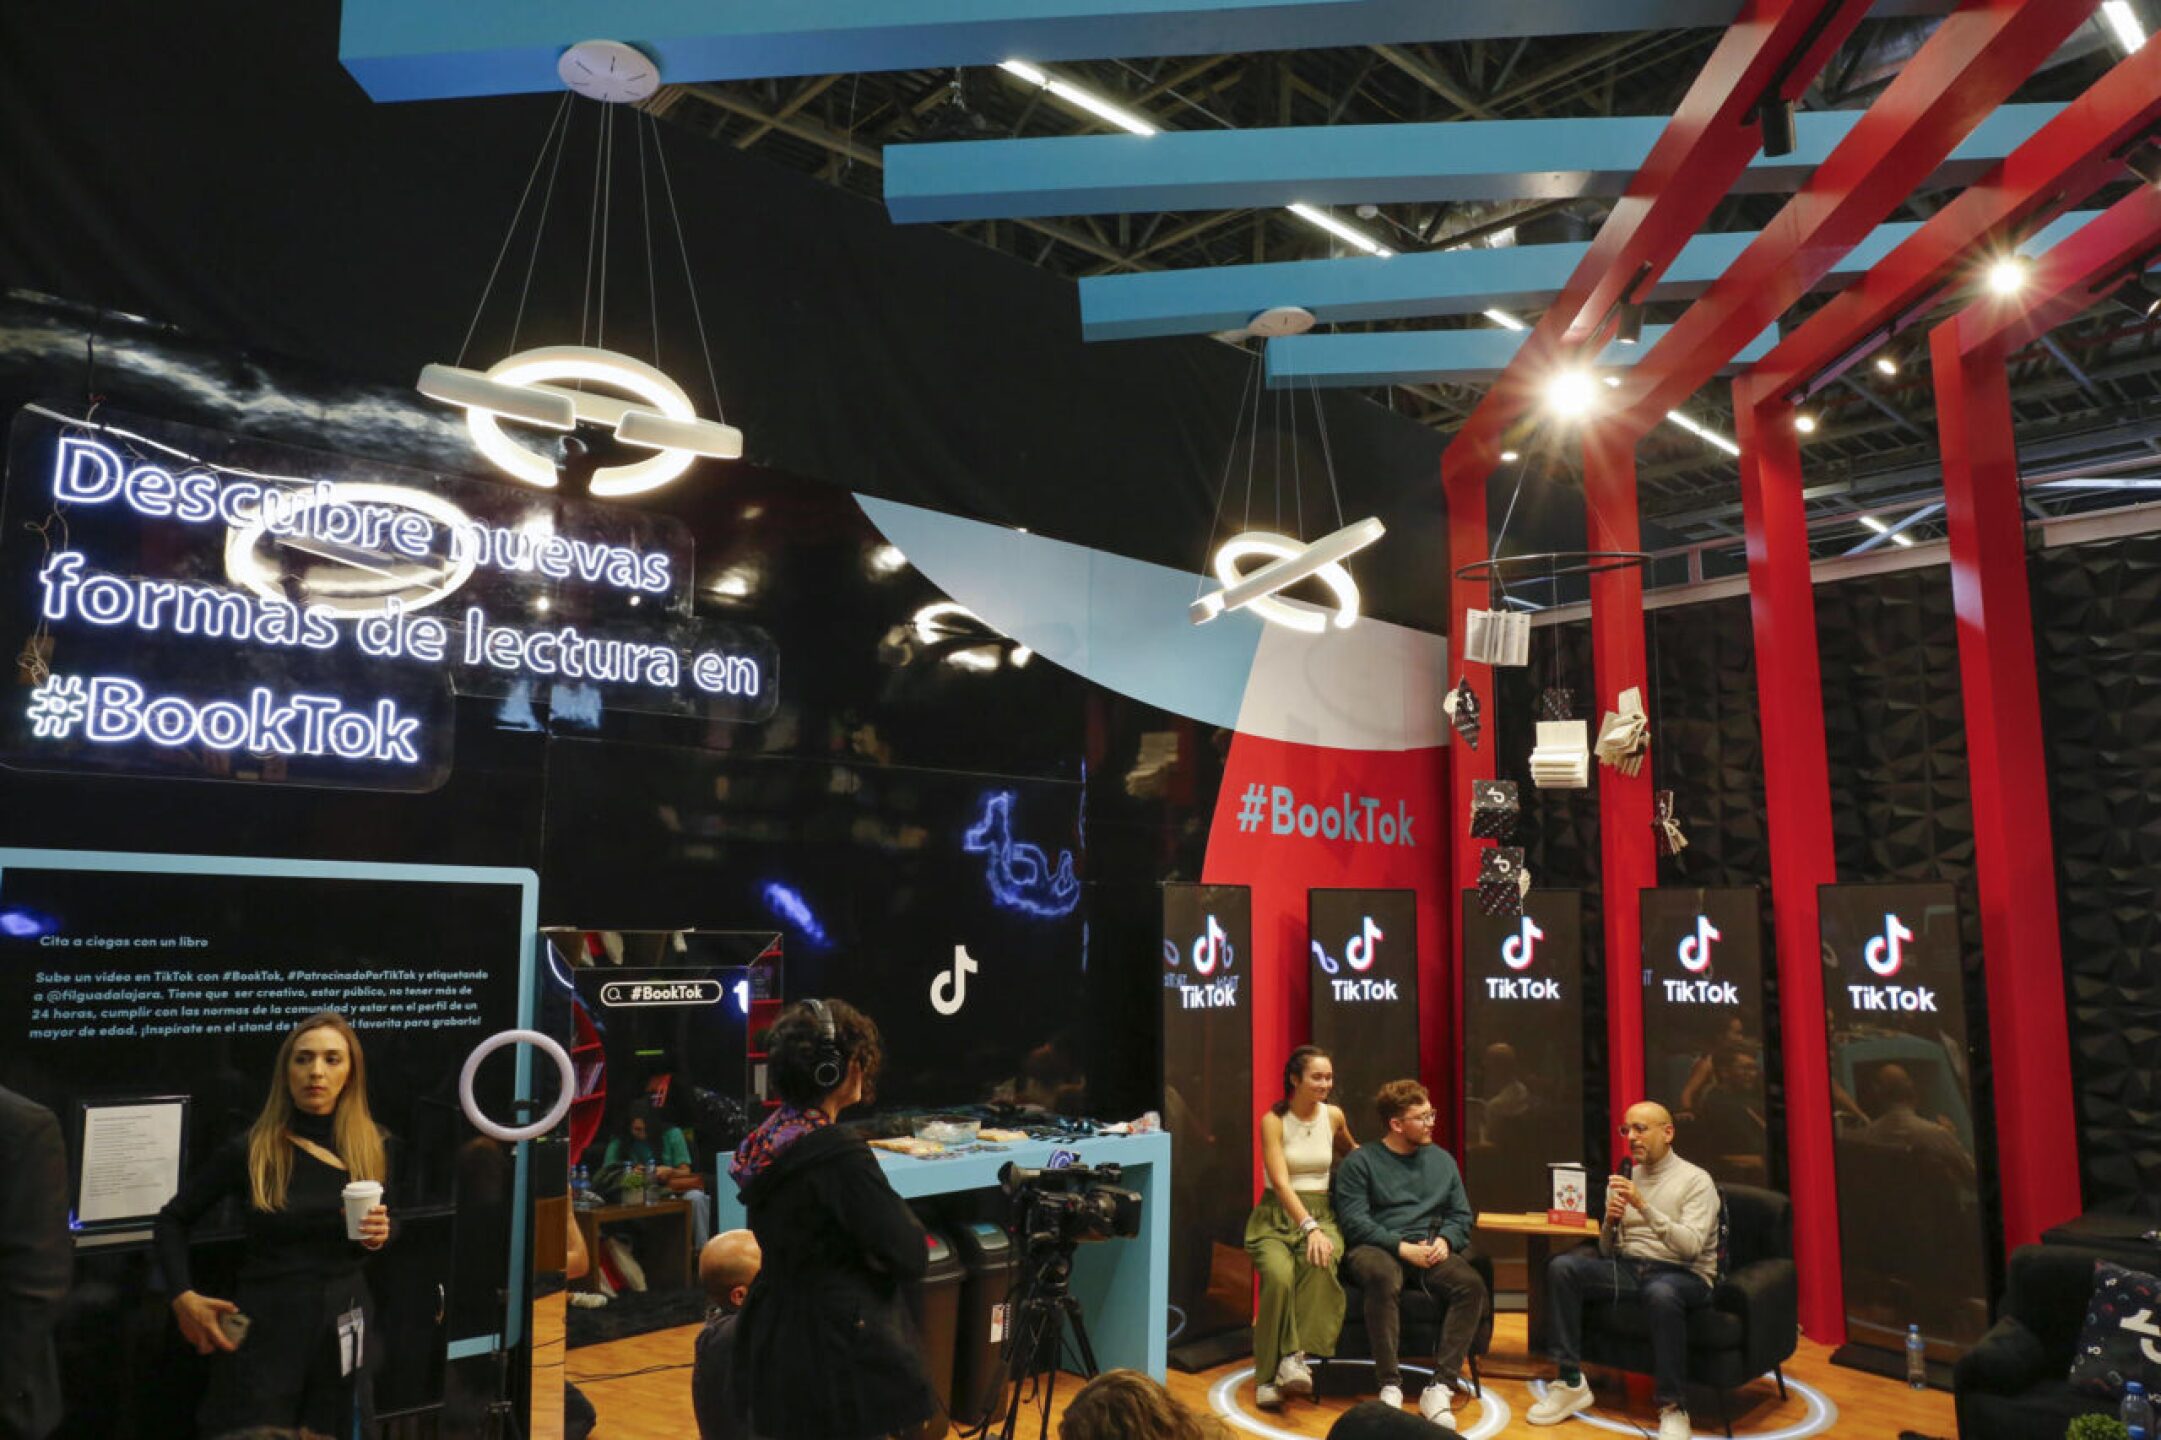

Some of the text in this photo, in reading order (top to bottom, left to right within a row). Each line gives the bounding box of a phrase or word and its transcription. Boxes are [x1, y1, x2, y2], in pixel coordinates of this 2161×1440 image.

[51, 436, 672, 593] Descubre nuevas
[38, 552, 760, 696] formas de lectura en
[27, 674, 419, 764] #BookTok
[1236, 783, 1416, 847] #BookTok
[40, 935, 209, 950] Cita a ciegas con un libro
[36, 972, 71, 984] Sube
[75, 973, 92, 982] un
[95, 971, 131, 983] video
[134, 973, 151, 982] en
[154, 971, 194, 982] TikTok
[197, 973, 219, 982] con
[222, 970, 284, 982] #BookTok,
[418, 972, 425, 982] y
[427, 969, 489, 982] etiquetando
[33, 993, 43, 1002] a
[46, 988, 164, 1004] @filguadalajara.
[168, 988, 202, 999] Tiene
[205, 989, 229, 1001] que
[234, 989, 253, 999] ser
[256, 986, 308, 999] creativo,
[311, 987, 341, 997] estar
[389, 988, 403, 996] no
[405, 986, 432, 996] tener
[459, 985, 472, 996] de
[630, 984, 703, 1000] #BookTok
[1179, 984, 1237, 1009] TikTok
[1331, 979, 1398, 1001] TikTok
[1485, 977, 1561, 1000] TikTok
[1663, 979, 1739, 1005] TikTok
[1847, 985, 1938, 1013] TikTok
[32, 1008, 50, 1020] 24
[53, 1008, 97, 1020] horas,
[100, 1006, 152, 1020] cumplir
[154, 1008, 178, 1017] con
[181, 1005, 200, 1017] las
[203, 1007, 249, 1016] normas
[252, 1004, 267, 1015] de
[271, 1003, 282, 1014] la
[350, 1004, 359, 1015] y
[359, 1002, 388, 1012] estar
[390, 1003, 404, 1011] en
[406, 1001, 416, 1012] el
[418, 1000, 447, 1014] perfil
[448, 1000, 462, 1011] de
[464, 1002, 477, 1010] un
[29, 1028, 76, 1040] mayor
[78, 1025, 96, 1037] de
[206, 1024, 222, 1033] en
[223, 1021, 236, 1032] el
[239, 1020, 273, 1032] stand
[276, 1020, 291, 1031] de
[359, 1018, 401, 1029] favorita
[403, 1019, 430, 1030] para
